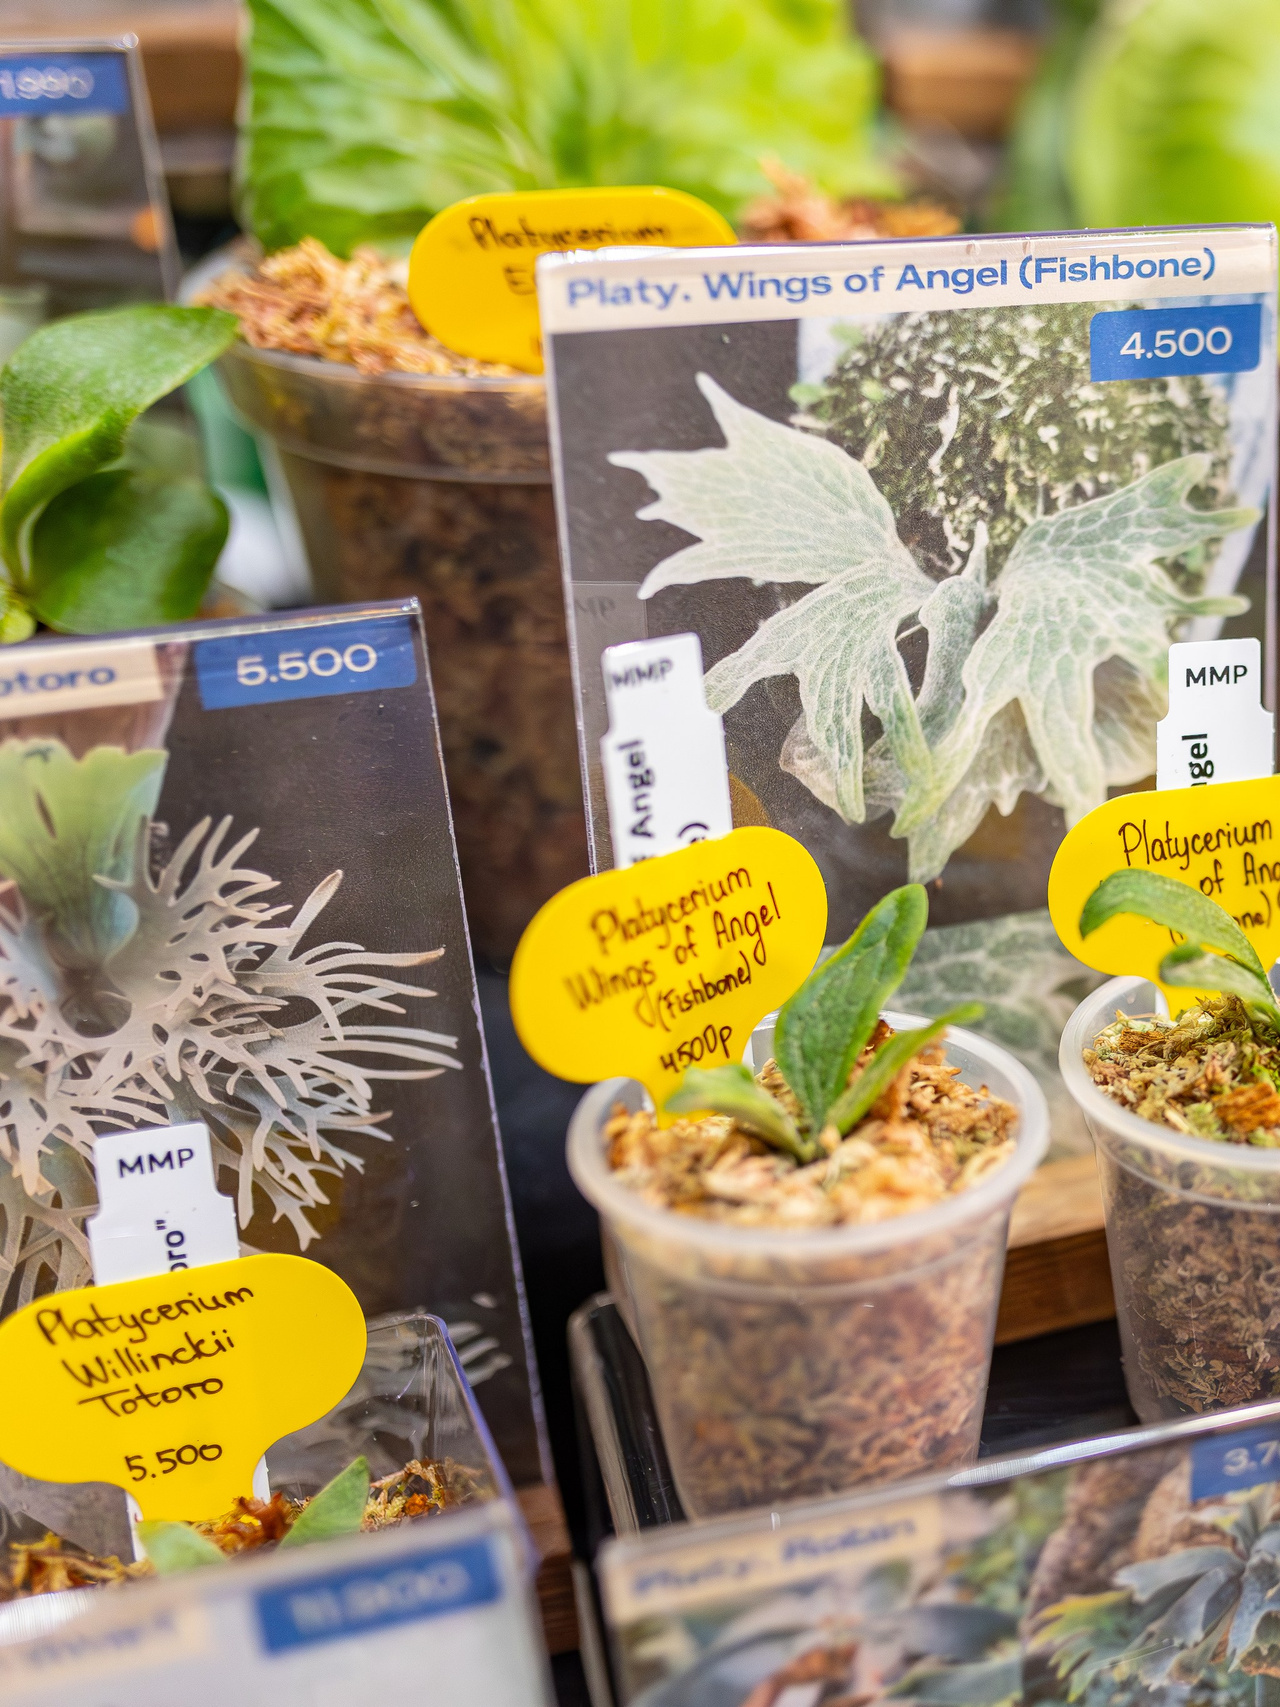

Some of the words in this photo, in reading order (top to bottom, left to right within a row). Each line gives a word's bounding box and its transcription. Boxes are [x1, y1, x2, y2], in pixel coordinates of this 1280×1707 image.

[567, 277, 691, 310] Platy.
[704, 268, 832, 303] Wings
[843, 265, 887, 295] of
[896, 259, 1008, 297] Angel
[1020, 246, 1216, 287] (Fishbone)
[1120, 326, 1233, 361] 4.500
[236, 643, 378, 687] 5.500
[609, 657, 674, 689] MMP
[1185, 664, 1248, 688] MMP
[1181, 733, 1215, 787] gel
[616, 738, 656, 840] Angel
[1118, 819, 1273, 870] Platycerium
[1200, 858, 1224, 896] of
[590, 866, 752, 956] Platycerium
[563, 957, 657, 1029] Wings
[675, 930, 700, 966] of
[712, 882, 782, 966] Angel
[117, 1146, 196, 1179] MMP
[36, 1285, 255, 1347] Platycerium
[78, 1376, 224, 1418] Totoro
[123, 1442, 223, 1482] 5.500
